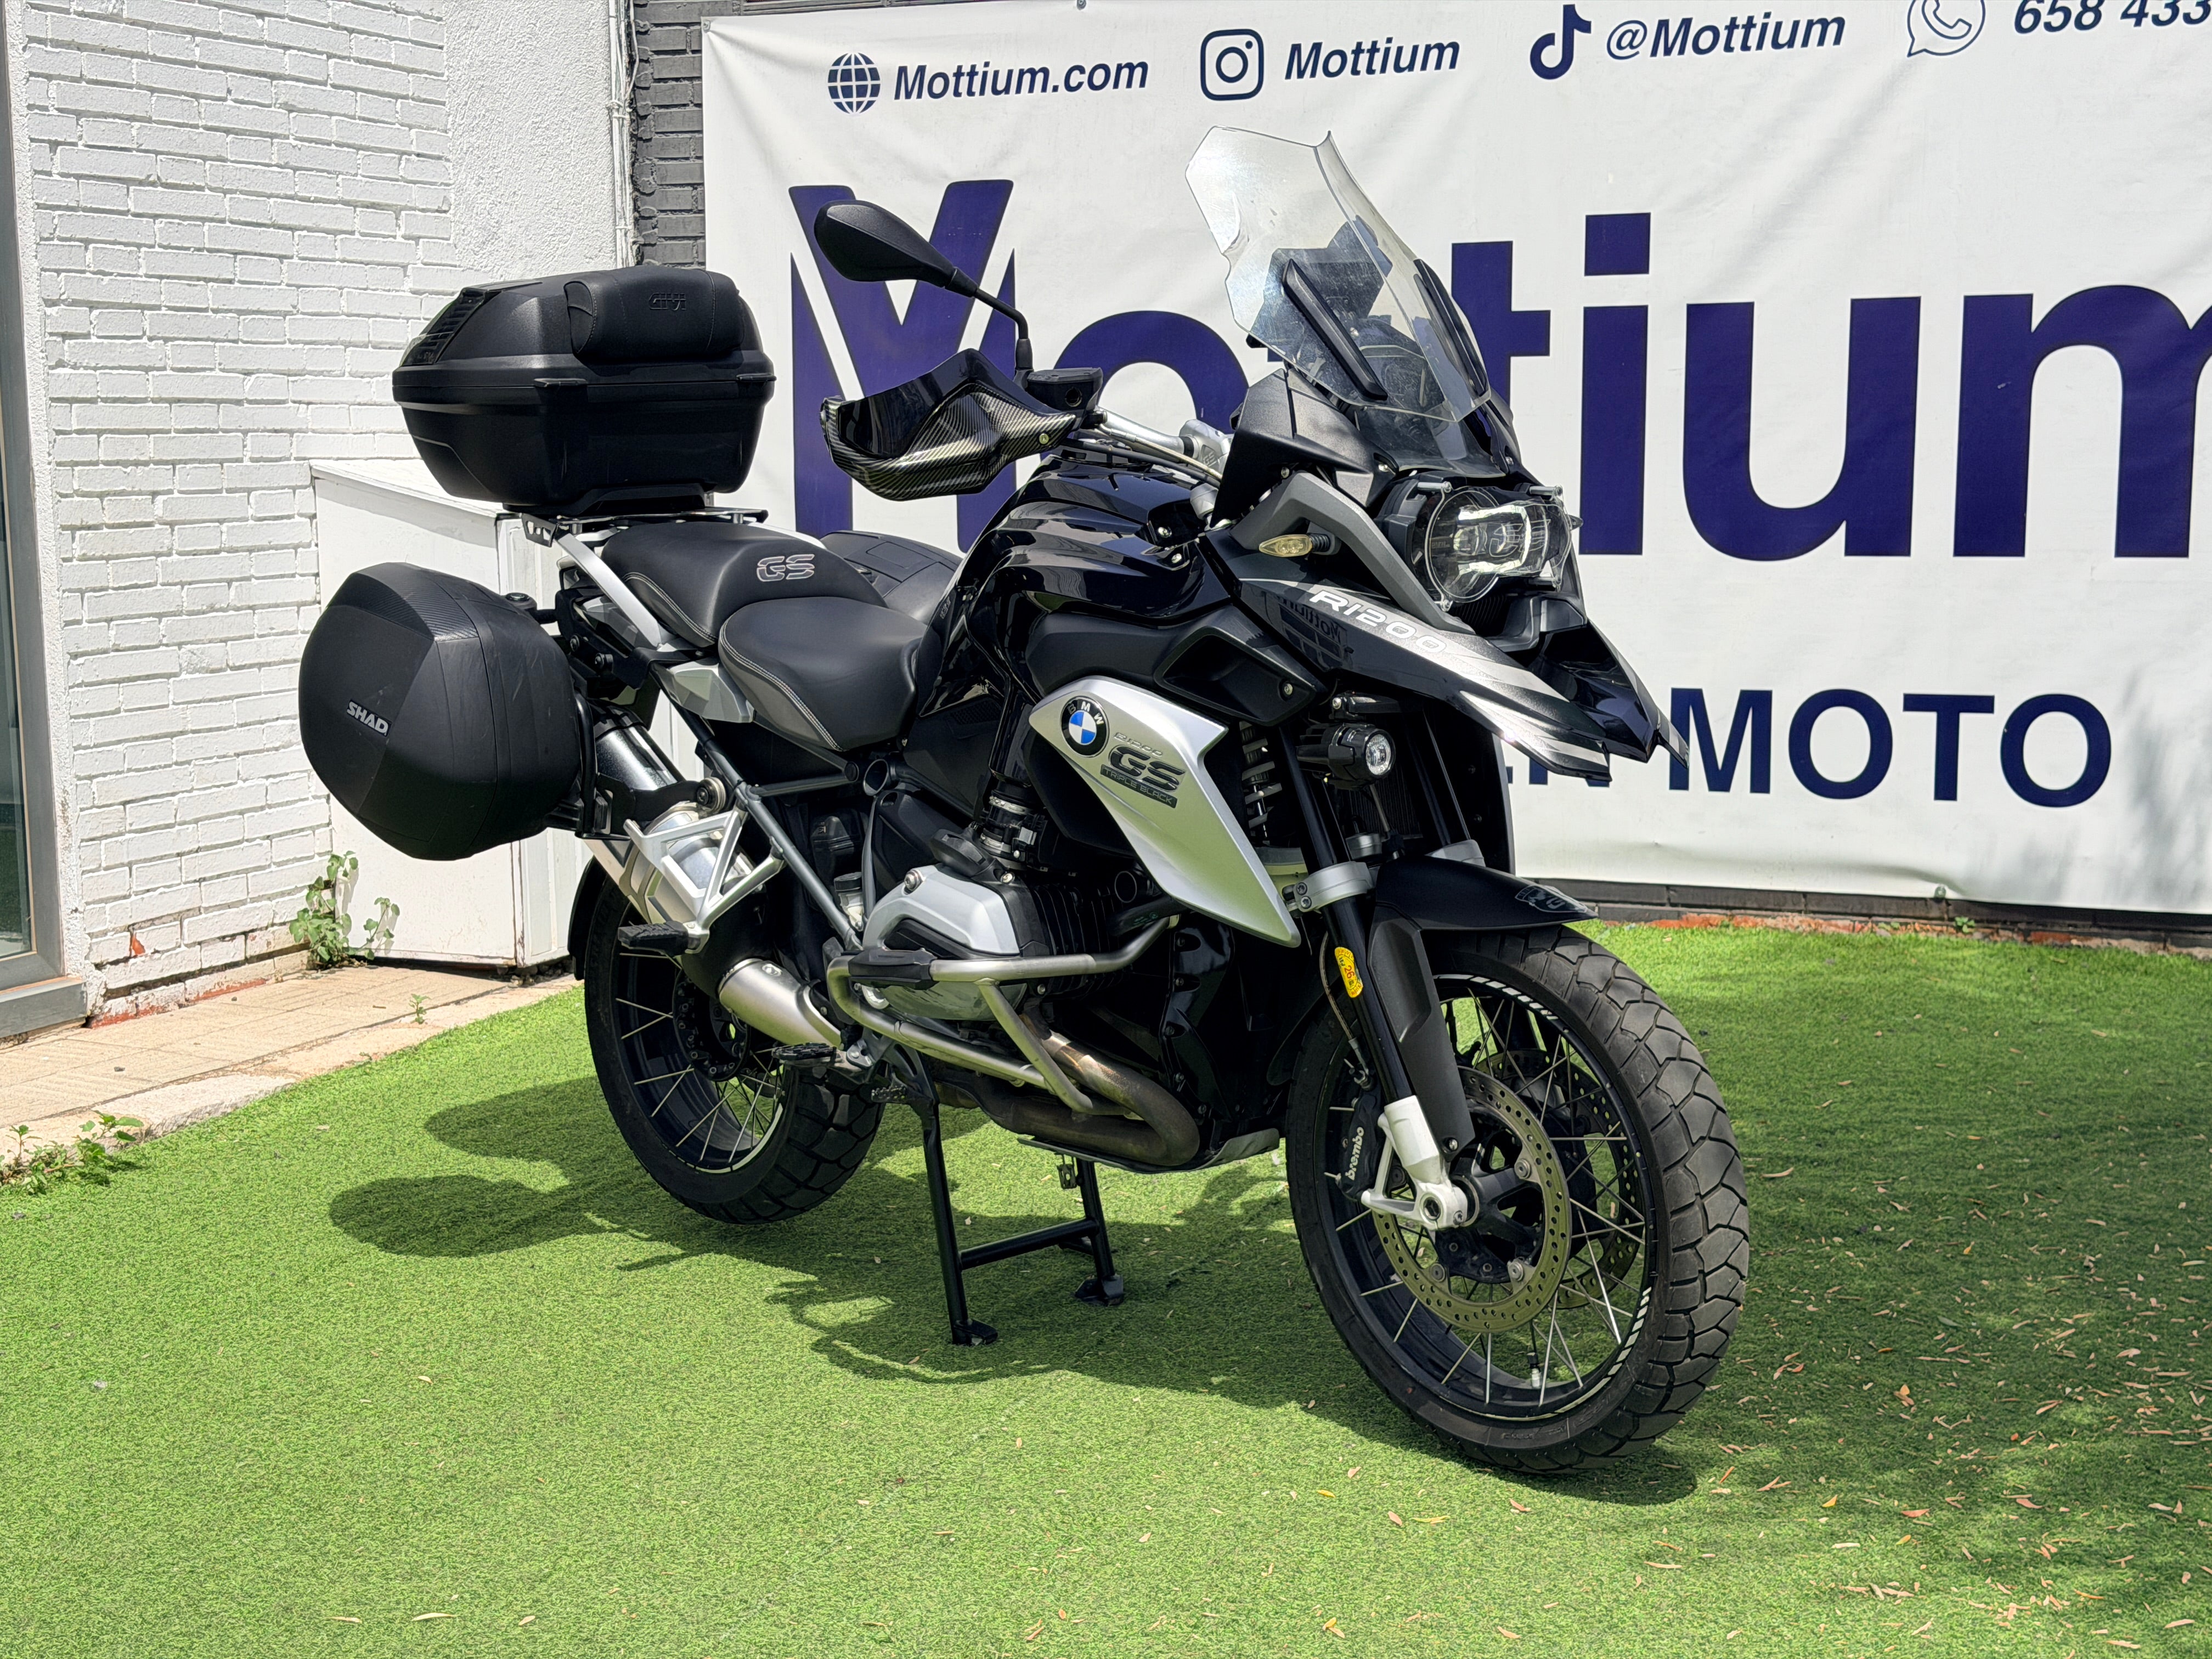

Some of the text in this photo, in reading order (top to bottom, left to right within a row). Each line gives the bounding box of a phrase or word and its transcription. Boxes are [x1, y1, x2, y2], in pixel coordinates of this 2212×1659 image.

[1606, 12, 1846, 60] @Mottium
[2014, 0, 2105, 34] 658
[1284, 37, 1460, 80] Mottium
[894, 60, 1148, 100] Mottium.com
[789, 179, 2212, 558] Motium
[756, 554, 815, 582] GS
[1309, 590, 1447, 654] R1200
[346, 701, 389, 735] SHAD
[1066, 701, 1104, 726] BMW
[1108, 744, 1186, 793] GS
[1668, 688, 2112, 808] MOTO
[1104, 768, 1173, 805] TRIPLE BLACK
[1344, 964, 1355, 979] 26
[1344, 1126, 1364, 1181] brembo
